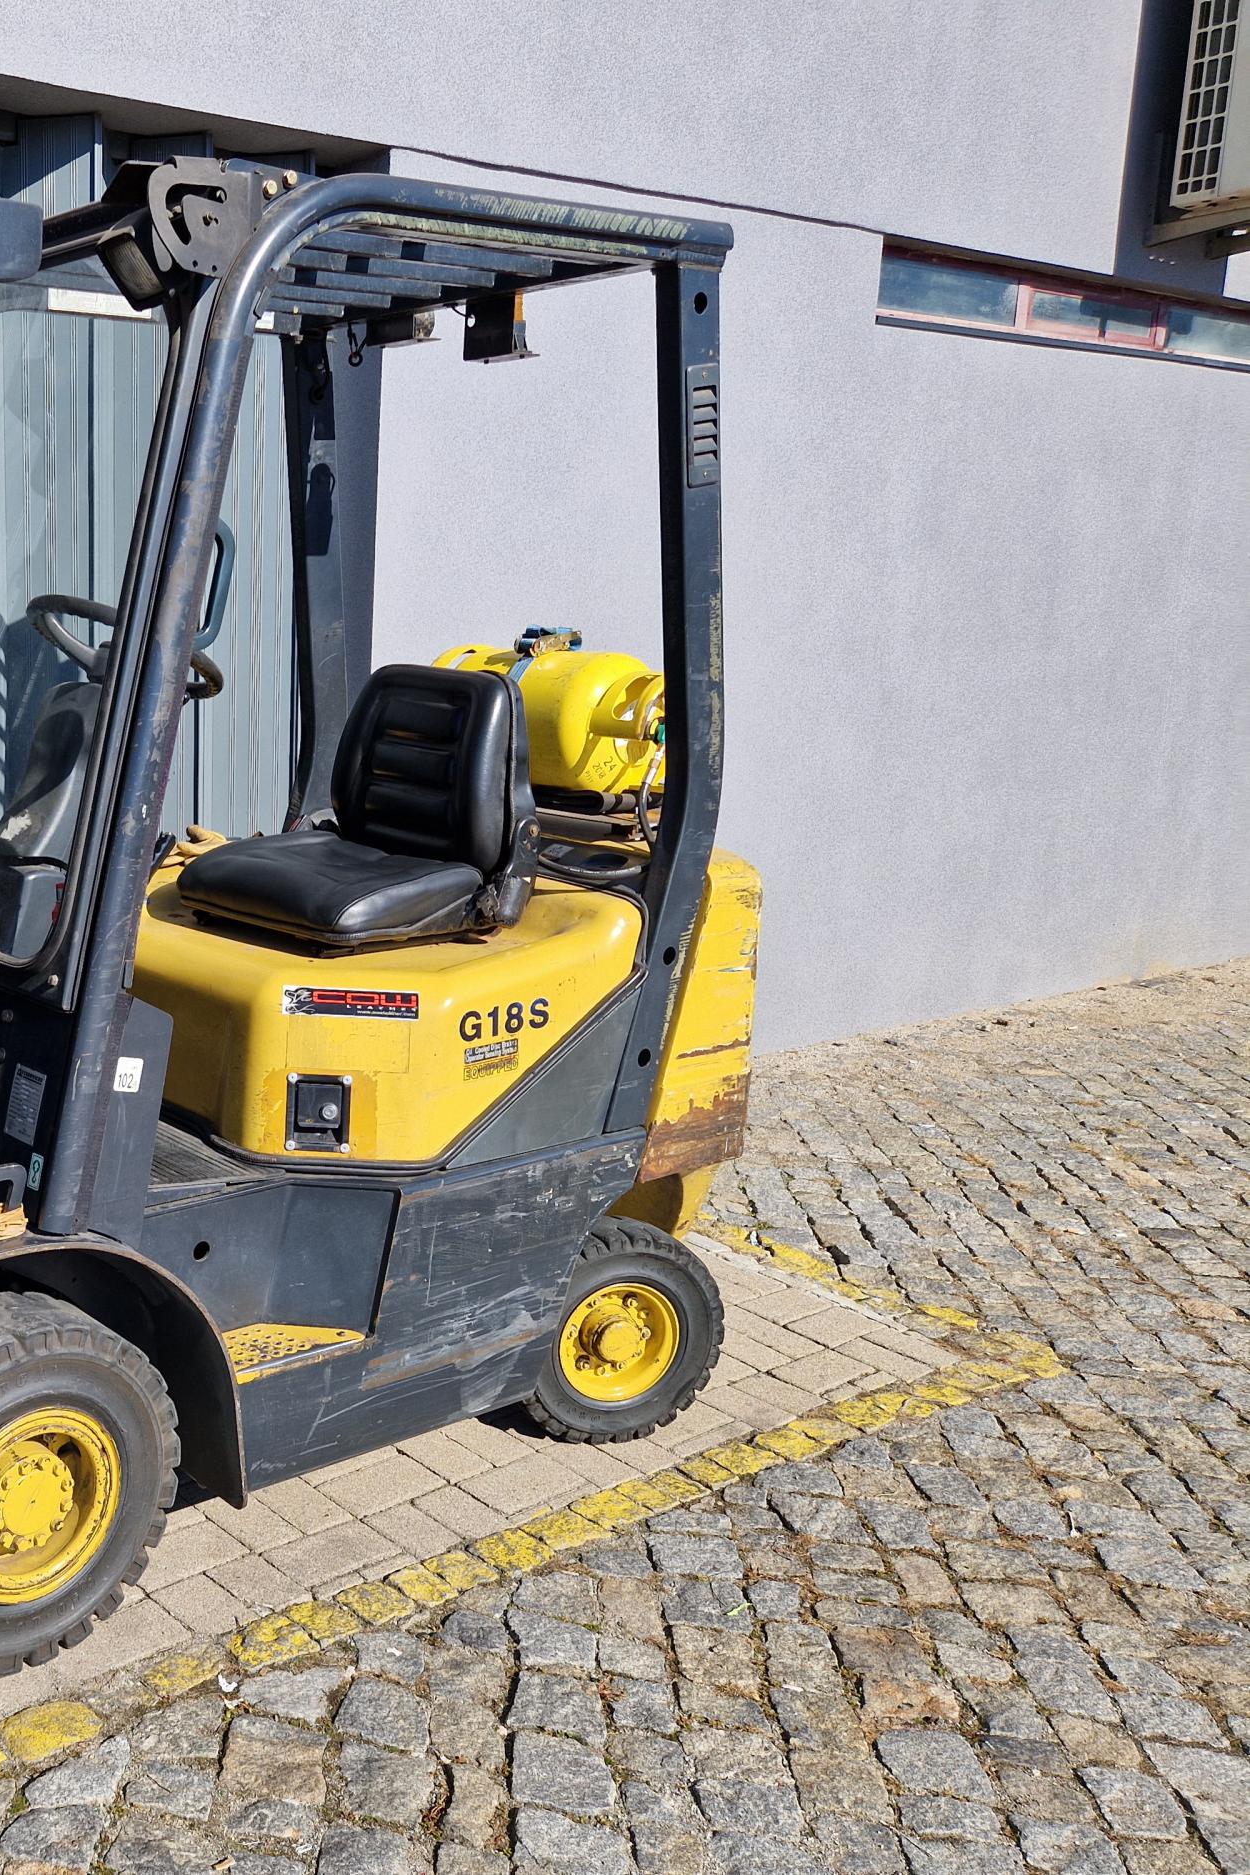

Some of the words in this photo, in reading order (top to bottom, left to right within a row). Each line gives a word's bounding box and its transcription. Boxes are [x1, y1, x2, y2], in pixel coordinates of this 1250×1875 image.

[312, 990, 418, 1007] COW
[459, 998, 549, 1042] G18S
[463, 1057, 518, 1081] EQUIPPED
[118, 1072, 134, 1089] 102
